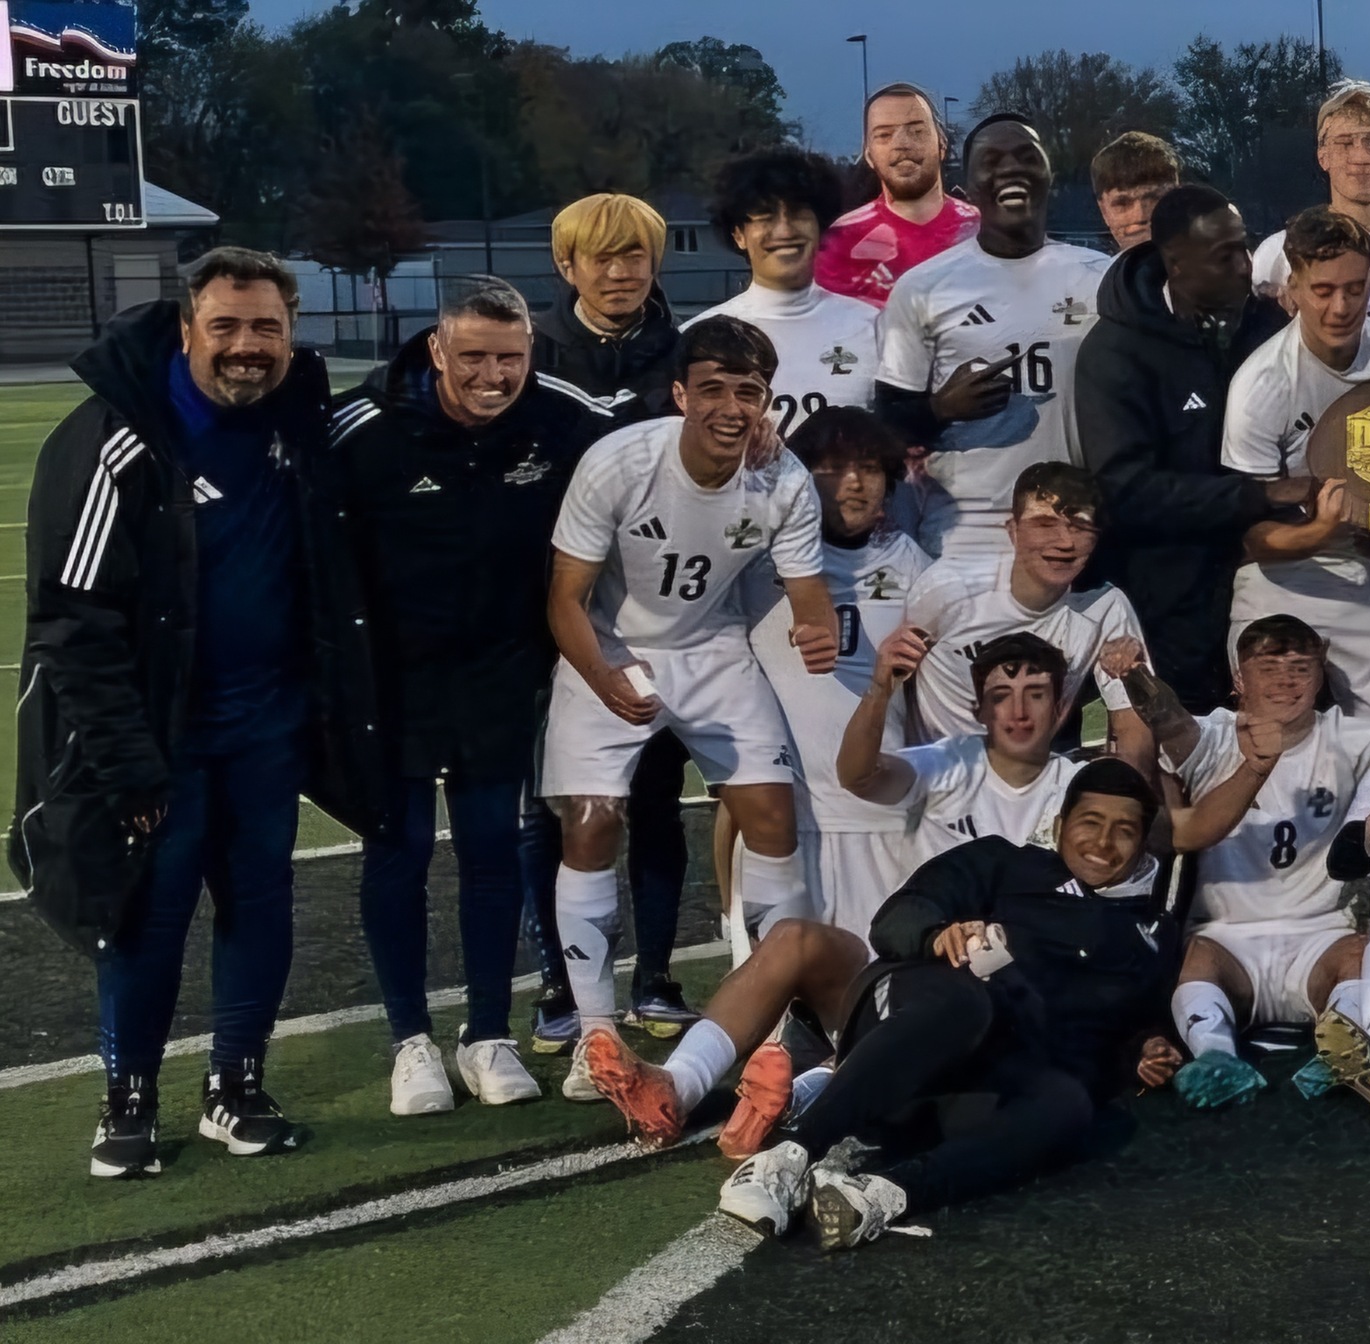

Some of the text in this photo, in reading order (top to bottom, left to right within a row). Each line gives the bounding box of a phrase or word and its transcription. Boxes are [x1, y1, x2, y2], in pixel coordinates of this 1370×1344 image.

[57, 101, 127, 126] GUEST
[1005, 341, 1053, 394] 16
[659, 553, 711, 602] 13
[1270, 820, 1298, 870] 8
